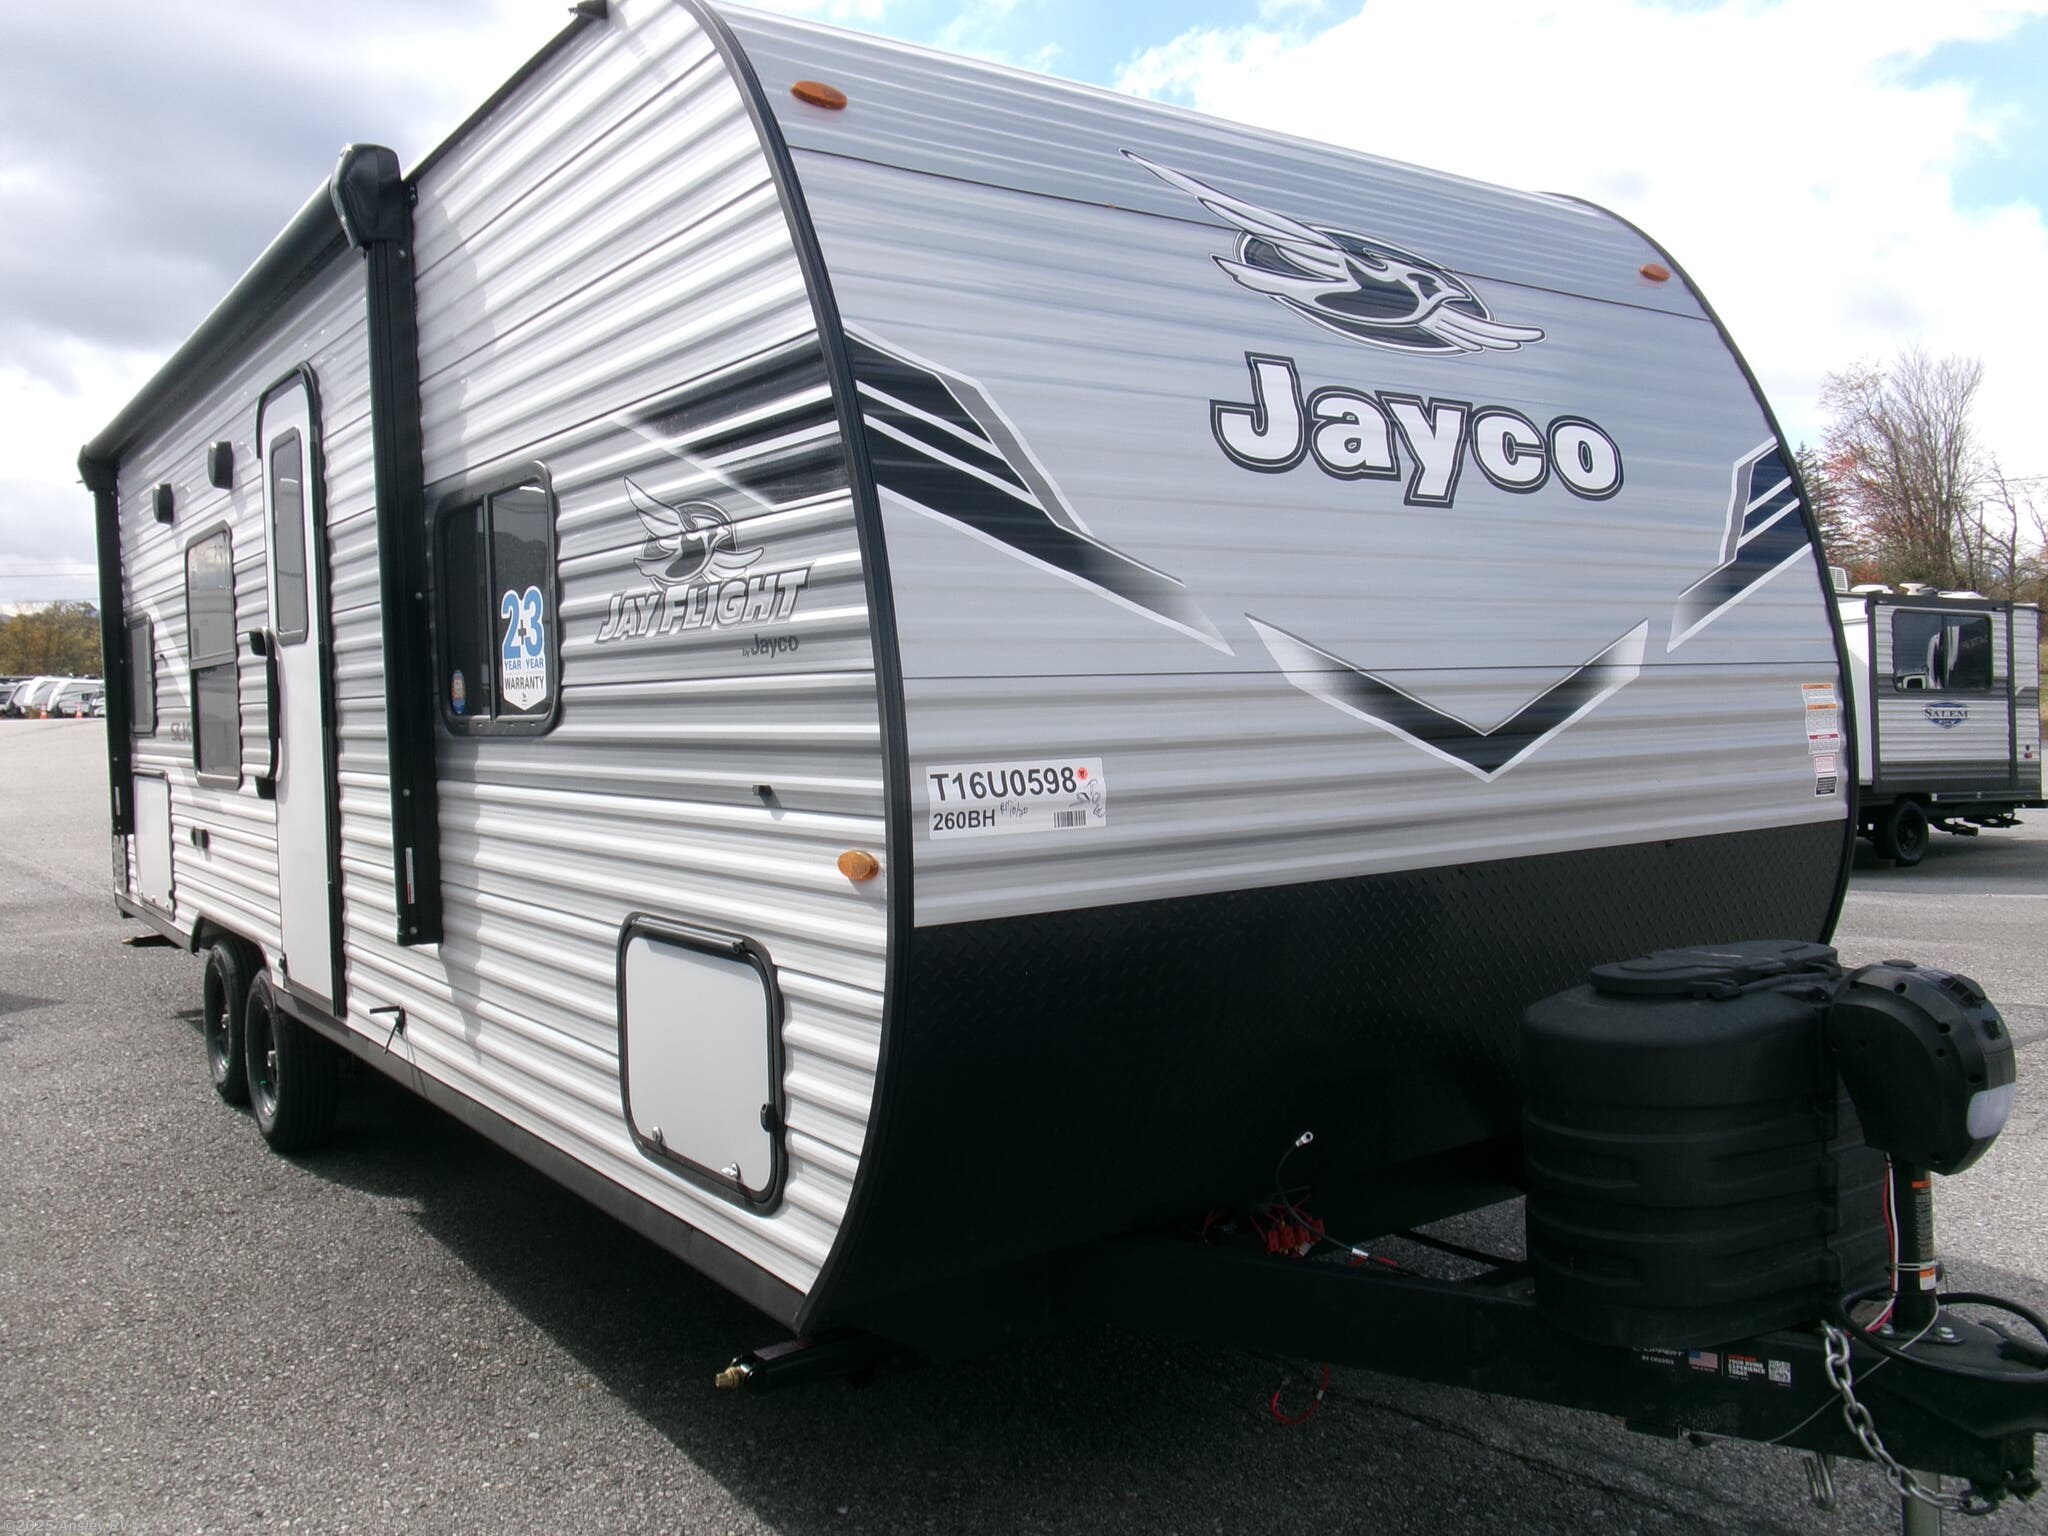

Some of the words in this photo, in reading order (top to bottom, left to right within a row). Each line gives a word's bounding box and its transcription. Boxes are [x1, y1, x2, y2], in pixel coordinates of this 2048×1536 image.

[1209, 350, 1624, 509] Jayco
[596, 590, 663, 643] JAY
[660, 566, 811, 633] FLIGHT
[742, 647, 750, 658] by
[751, 634, 800, 658] Jayco
[504, 659, 522, 671] YEAR
[525, 657, 544, 669] YEAR
[504, 676, 545, 690] WARRANTY
[1923, 708, 1969, 718] SALEM
[930, 767, 1078, 802] T16U0598
[933, 809, 996, 831] 260BH
